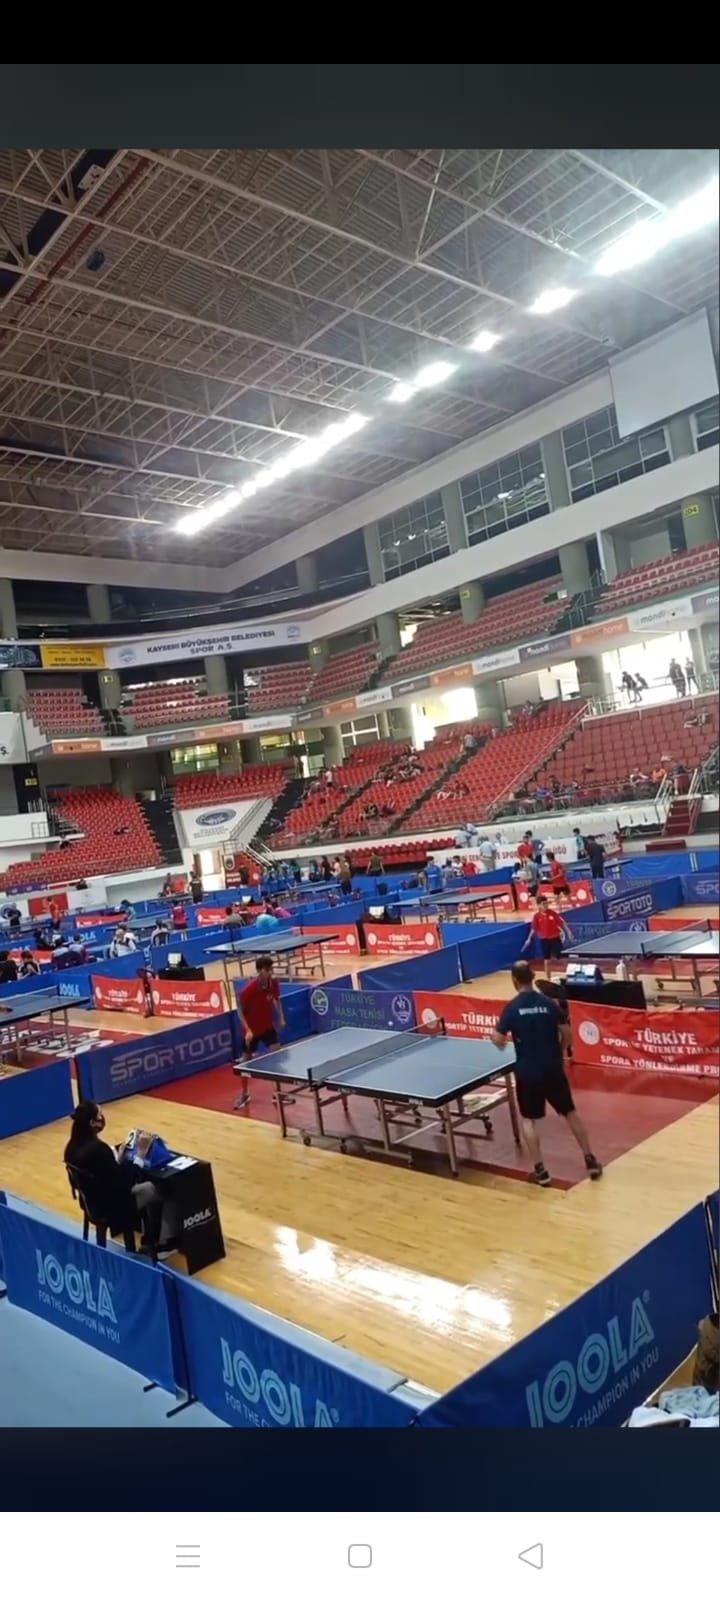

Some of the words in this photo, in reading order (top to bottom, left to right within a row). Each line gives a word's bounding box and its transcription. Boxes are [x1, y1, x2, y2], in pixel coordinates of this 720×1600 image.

[180, 634, 230, 649] BÜYÜKŞEHİR
[231, 629, 275, 642] BELEDİYESİ
[189, 644, 215, 655] SPOR
[607, 893, 653, 920] SPORTOTO
[634, 1027, 698, 1046] TÜRKİYE
[642, 1043, 685, 1055] YETENEK
[110, 1028, 232, 1083] SPORTOTO
[600, 1054, 632, 1067] SPORA
[183, 1207, 212, 1229] JOOLA
[35, 1247, 118, 1324] JOOLA
[38, 1289, 51, 1306] FOR
[51, 1295, 64, 1313] THE
[63, 1303, 98, 1332] CHAMPION
[98, 1320, 106, 1336] IN
[106, 1325, 120, 1345] YOU
[526, 1296, 655, 1428] JOOLA
[630, 1365, 641, 1386] IN
[642, 1346, 659, 1373] YOU
[224, 1390, 243, 1415] FOR
